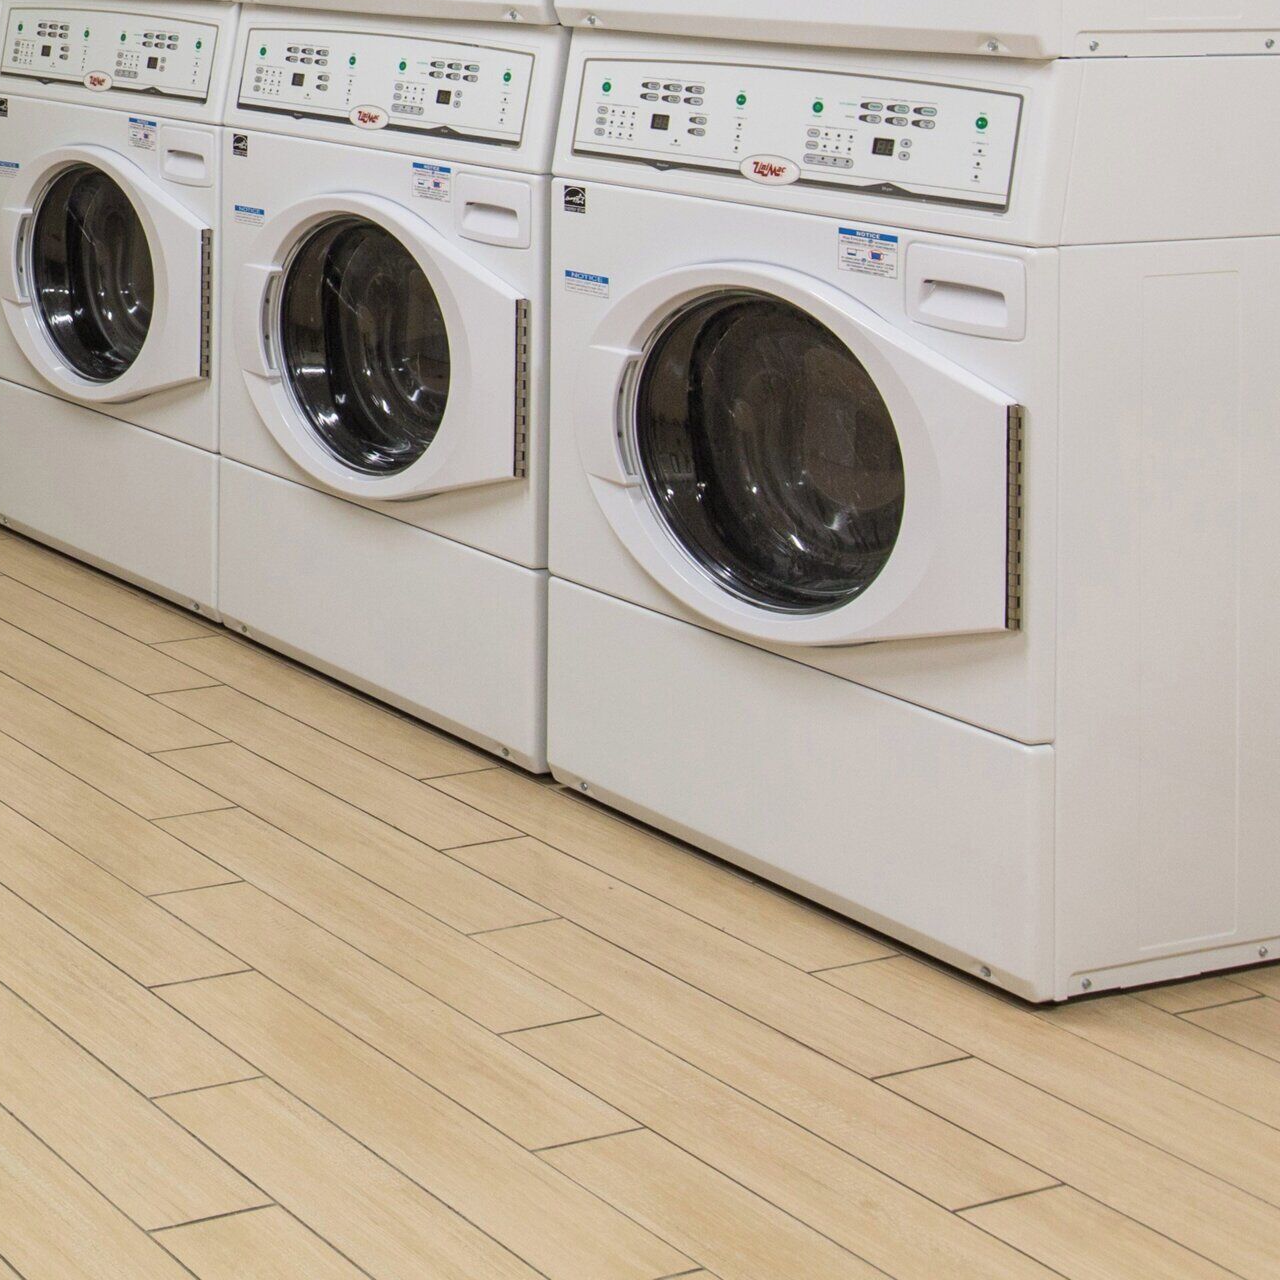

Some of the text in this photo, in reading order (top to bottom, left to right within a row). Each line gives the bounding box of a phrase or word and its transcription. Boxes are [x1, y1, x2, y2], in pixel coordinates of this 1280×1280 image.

[753, 161, 786, 177] UniMac
[856, 231, 881, 240] NOTICE
[570, 272, 603, 283] NOTICE
